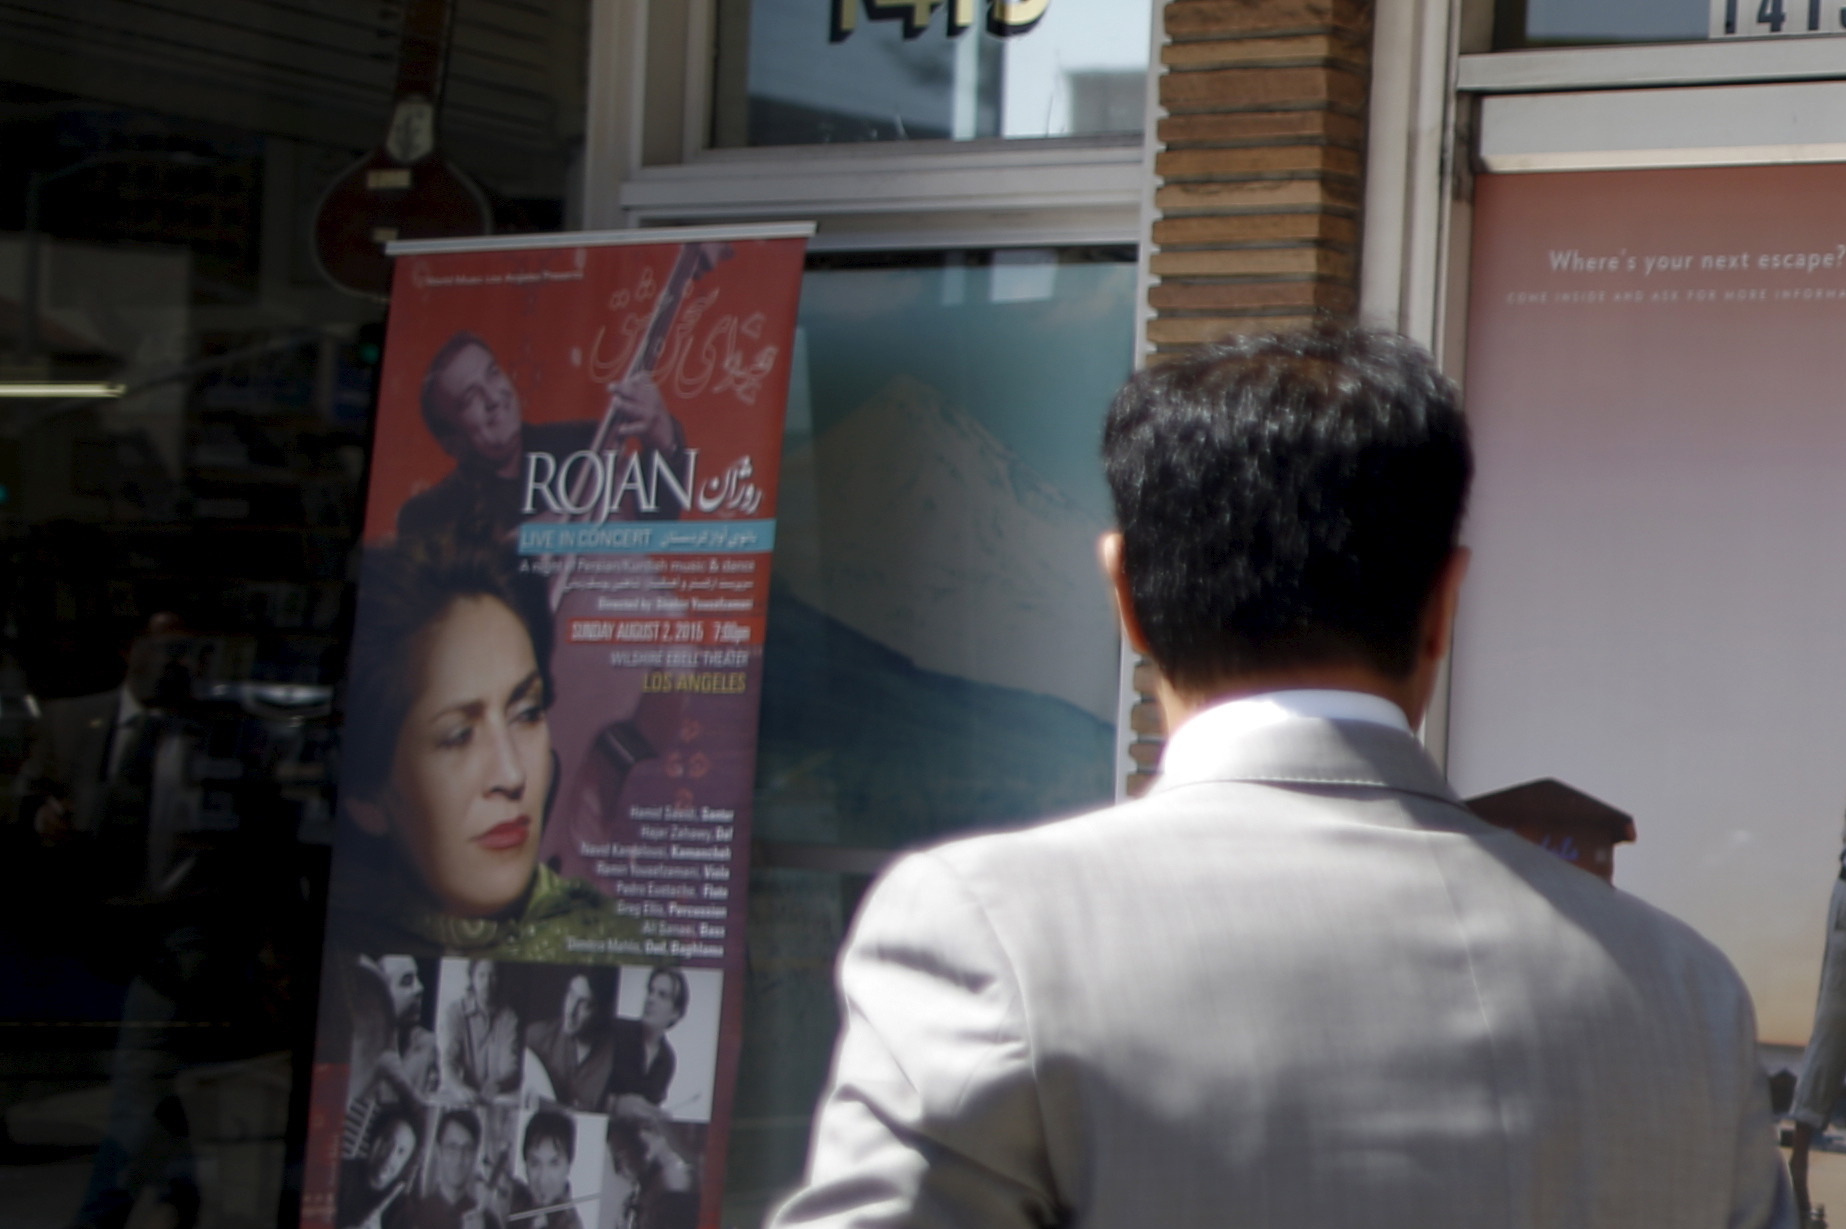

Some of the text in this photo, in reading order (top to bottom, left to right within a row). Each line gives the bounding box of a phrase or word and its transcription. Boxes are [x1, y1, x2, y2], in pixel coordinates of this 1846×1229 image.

[1548, 244, 1846, 277] Where's your next escape?
[1687, 289, 1717, 301] FOR
[1724, 288, 1766, 301] MORE
[521, 448, 700, 527] ROJAN
[521, 528, 653, 548] LIVE IN CONCERT
[571, 621, 615, 641] SUNDAY
[616, 621, 660, 640] AUGUST
[643, 672, 747, 693] LOS ANGELES
